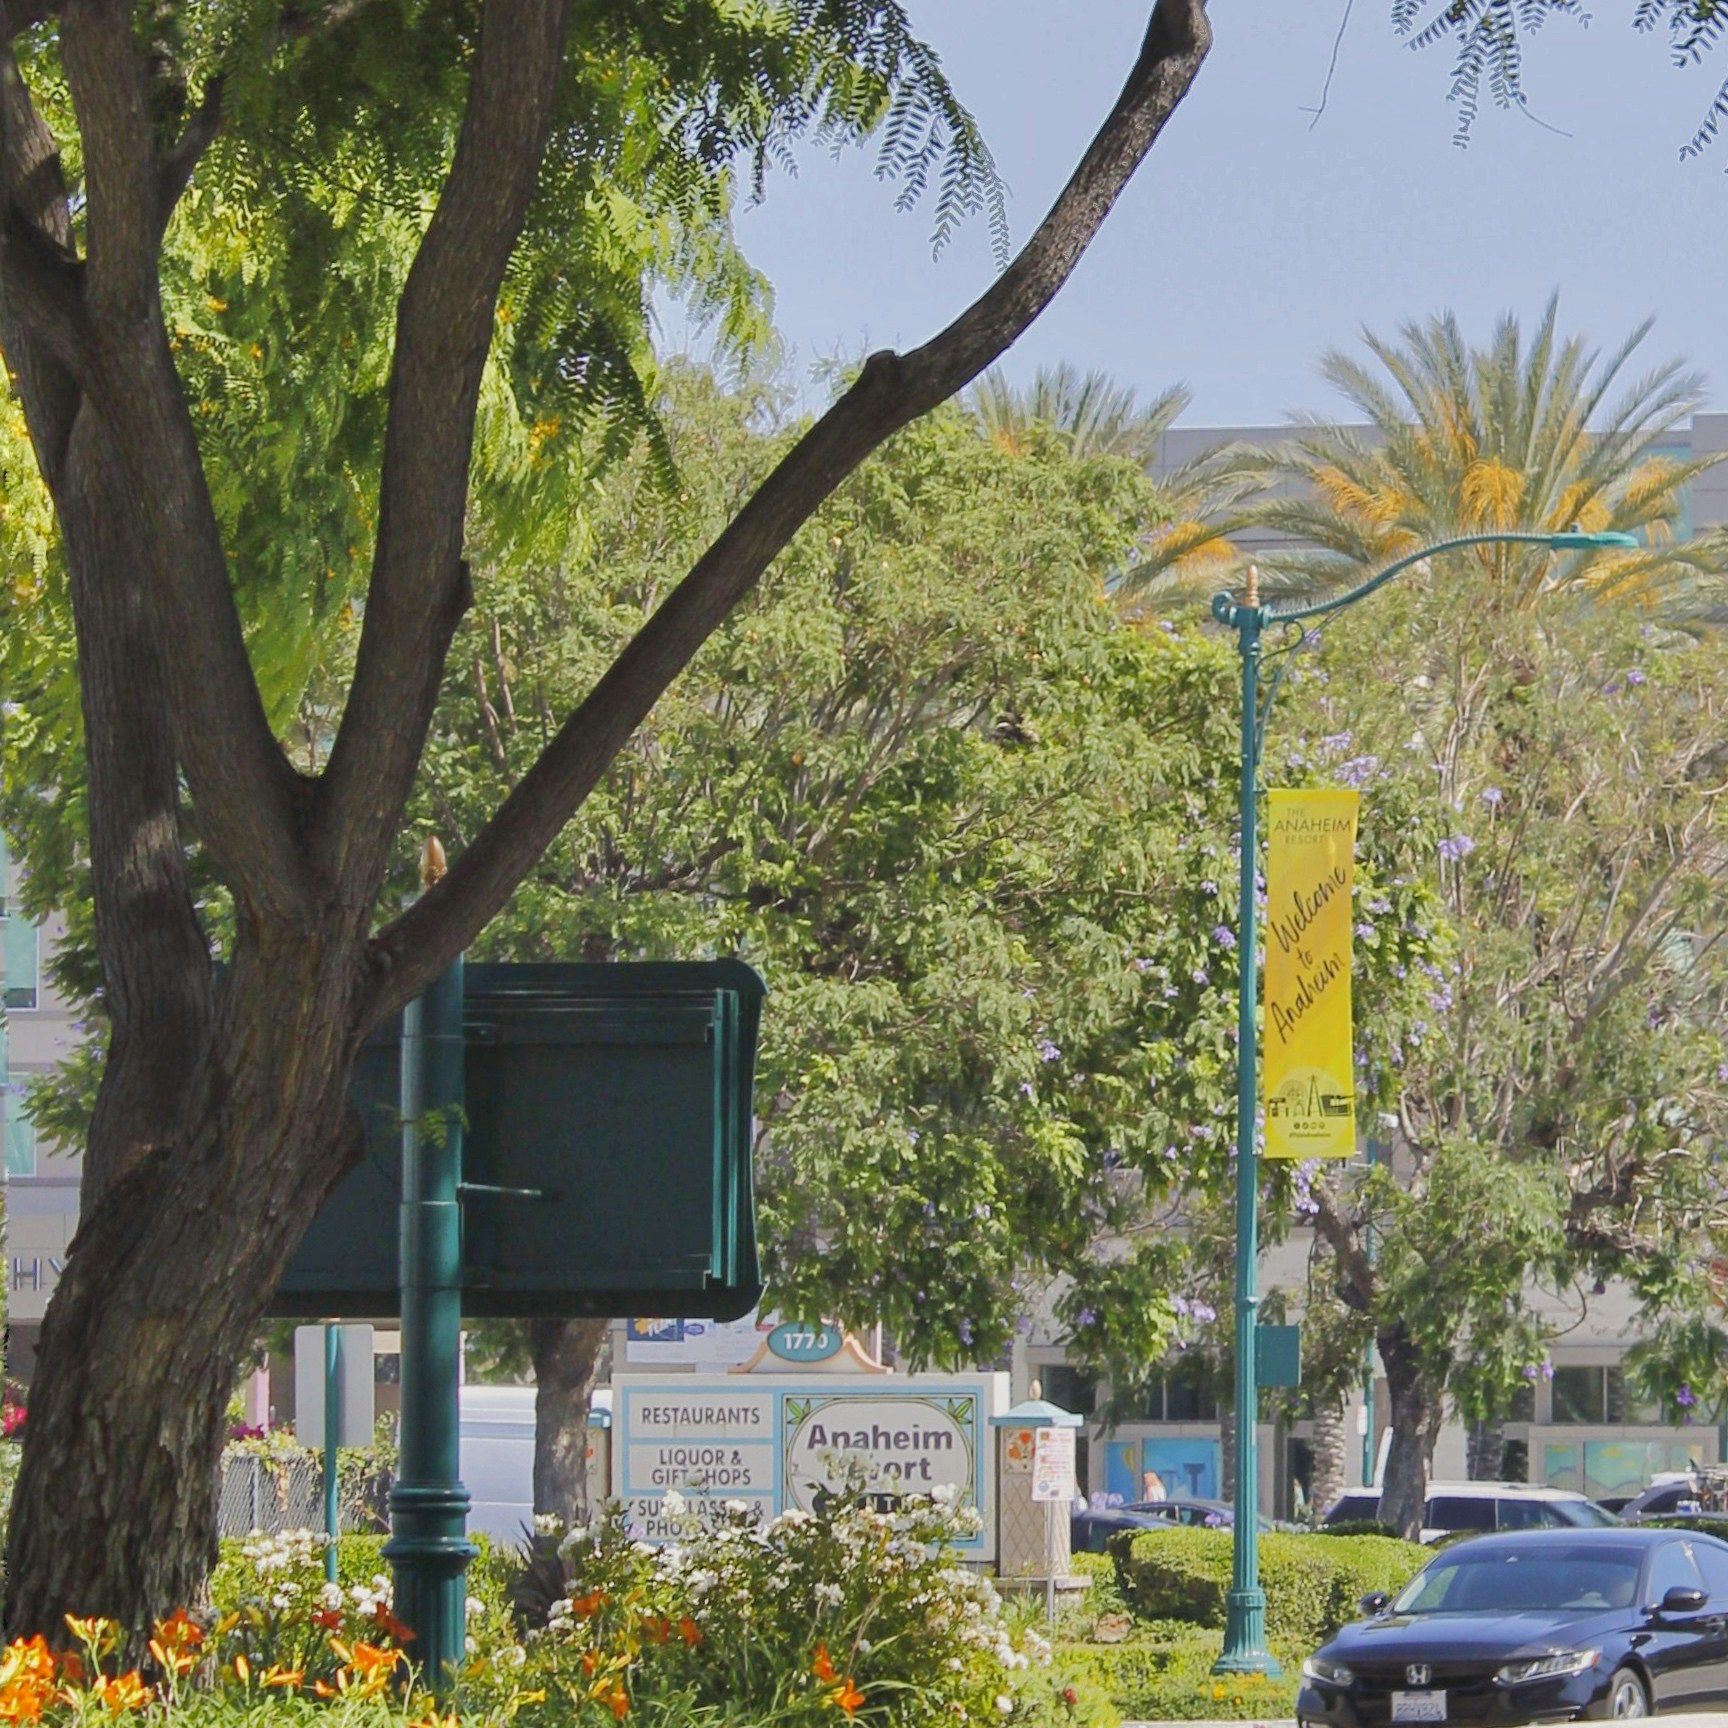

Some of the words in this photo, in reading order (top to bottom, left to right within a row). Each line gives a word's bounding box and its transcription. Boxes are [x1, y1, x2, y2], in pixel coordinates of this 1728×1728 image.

[1286, 807, 1305, 818] THE
[1273, 818, 1352, 833] ANAHEIM
[1284, 834, 1325, 846] RESORT
[1270, 865, 1347, 954] Welcome
[1296, 947, 1314, 970] to
[1270, 952, 1346, 1045] Anaheim
[783, 1333, 829, 1350] 1770
[641, 1407, 761, 1425] RESTAURANTS
[806, 1424, 953, 1450] Anaheim
[659, 1448, 725, 1466] LIQUOR
[730, 1449, 742, 1466] &
[651, 1468, 688, 1485] GIFT
[637, 1499, 736, 1517] SULASS
[753, 1499, 765, 1517] &
